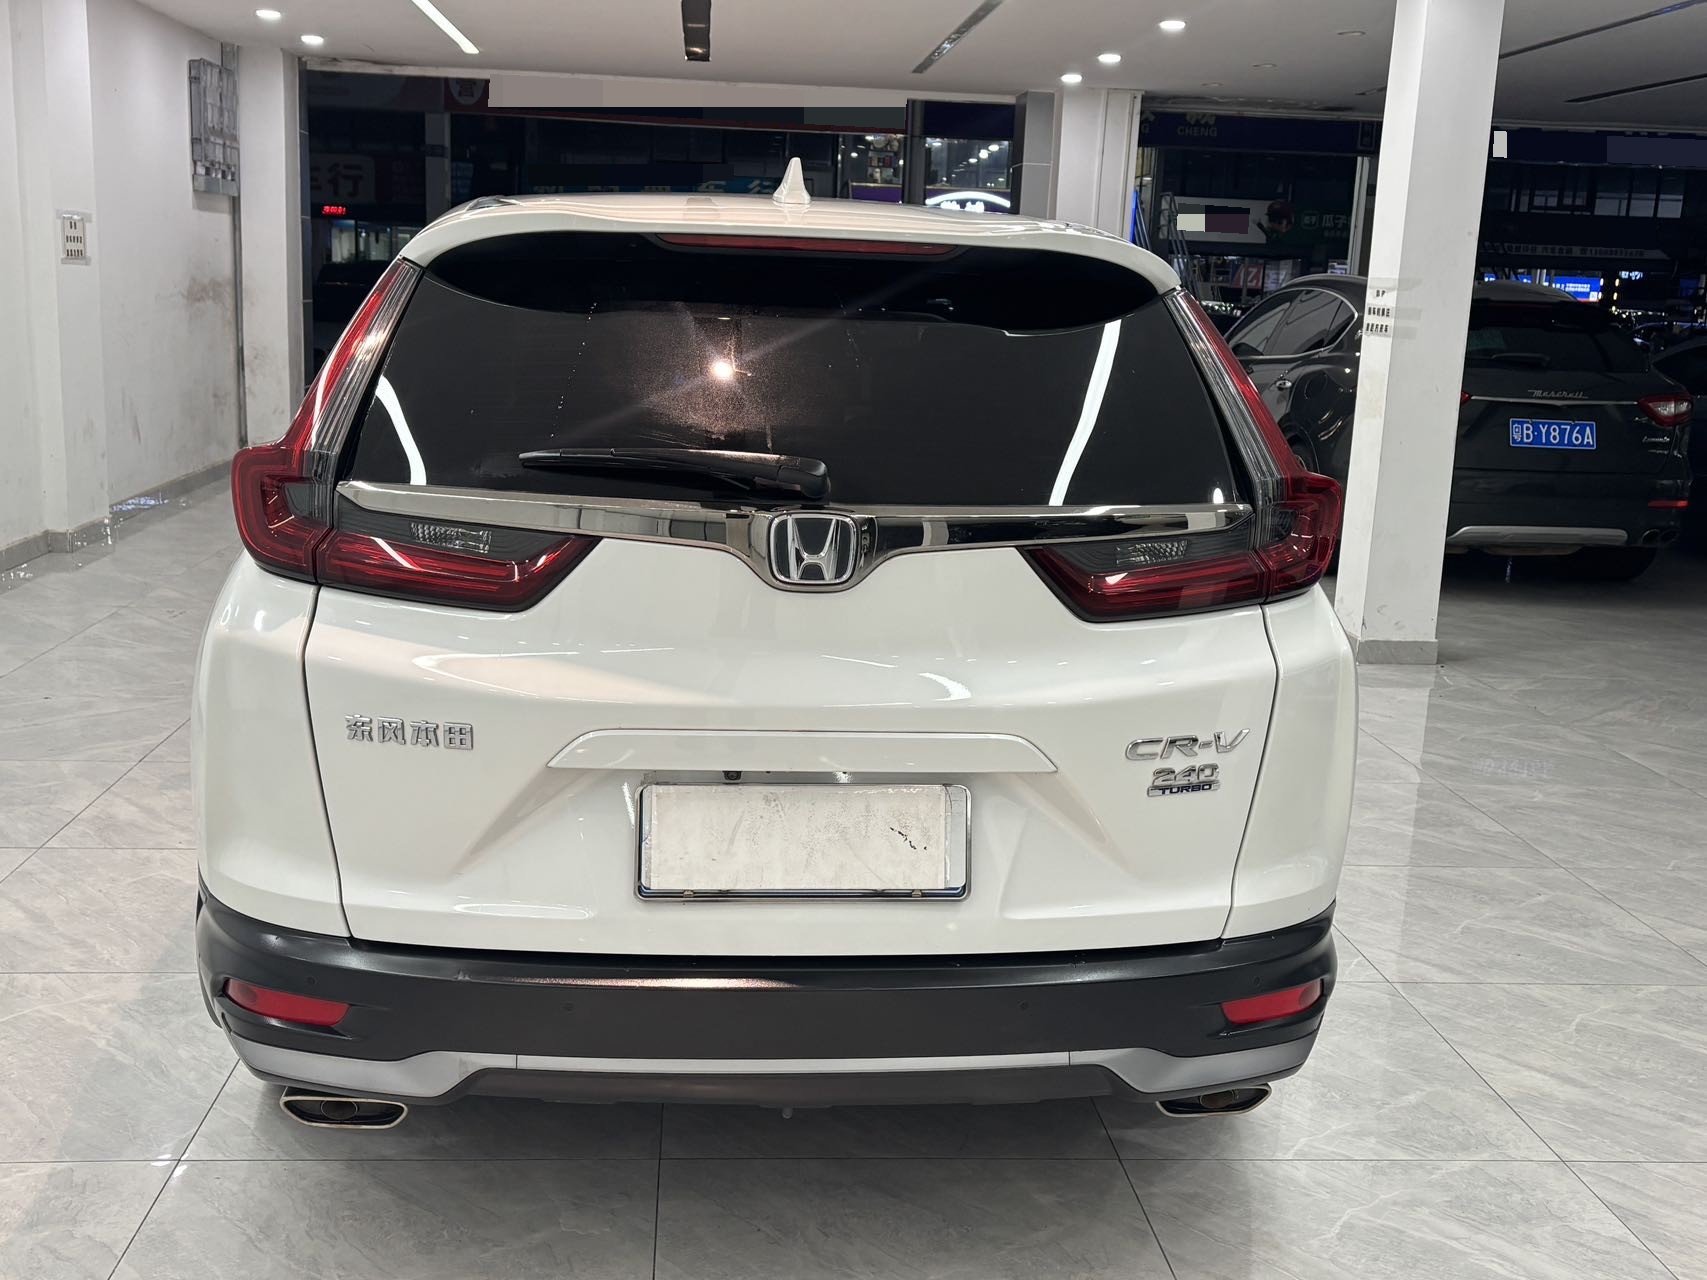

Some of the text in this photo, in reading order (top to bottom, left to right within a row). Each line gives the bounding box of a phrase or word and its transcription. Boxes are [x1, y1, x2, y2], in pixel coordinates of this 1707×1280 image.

[1176, 125, 1218, 137] CHENG
[1321, 214, 1351, 229] 瓜子
[344, 713, 475, 751] 东风本田
[1125, 728, 1250, 761] CR-V
[1152, 763, 1219, 786] 240
[1160, 783, 1213, 796] TURBO
